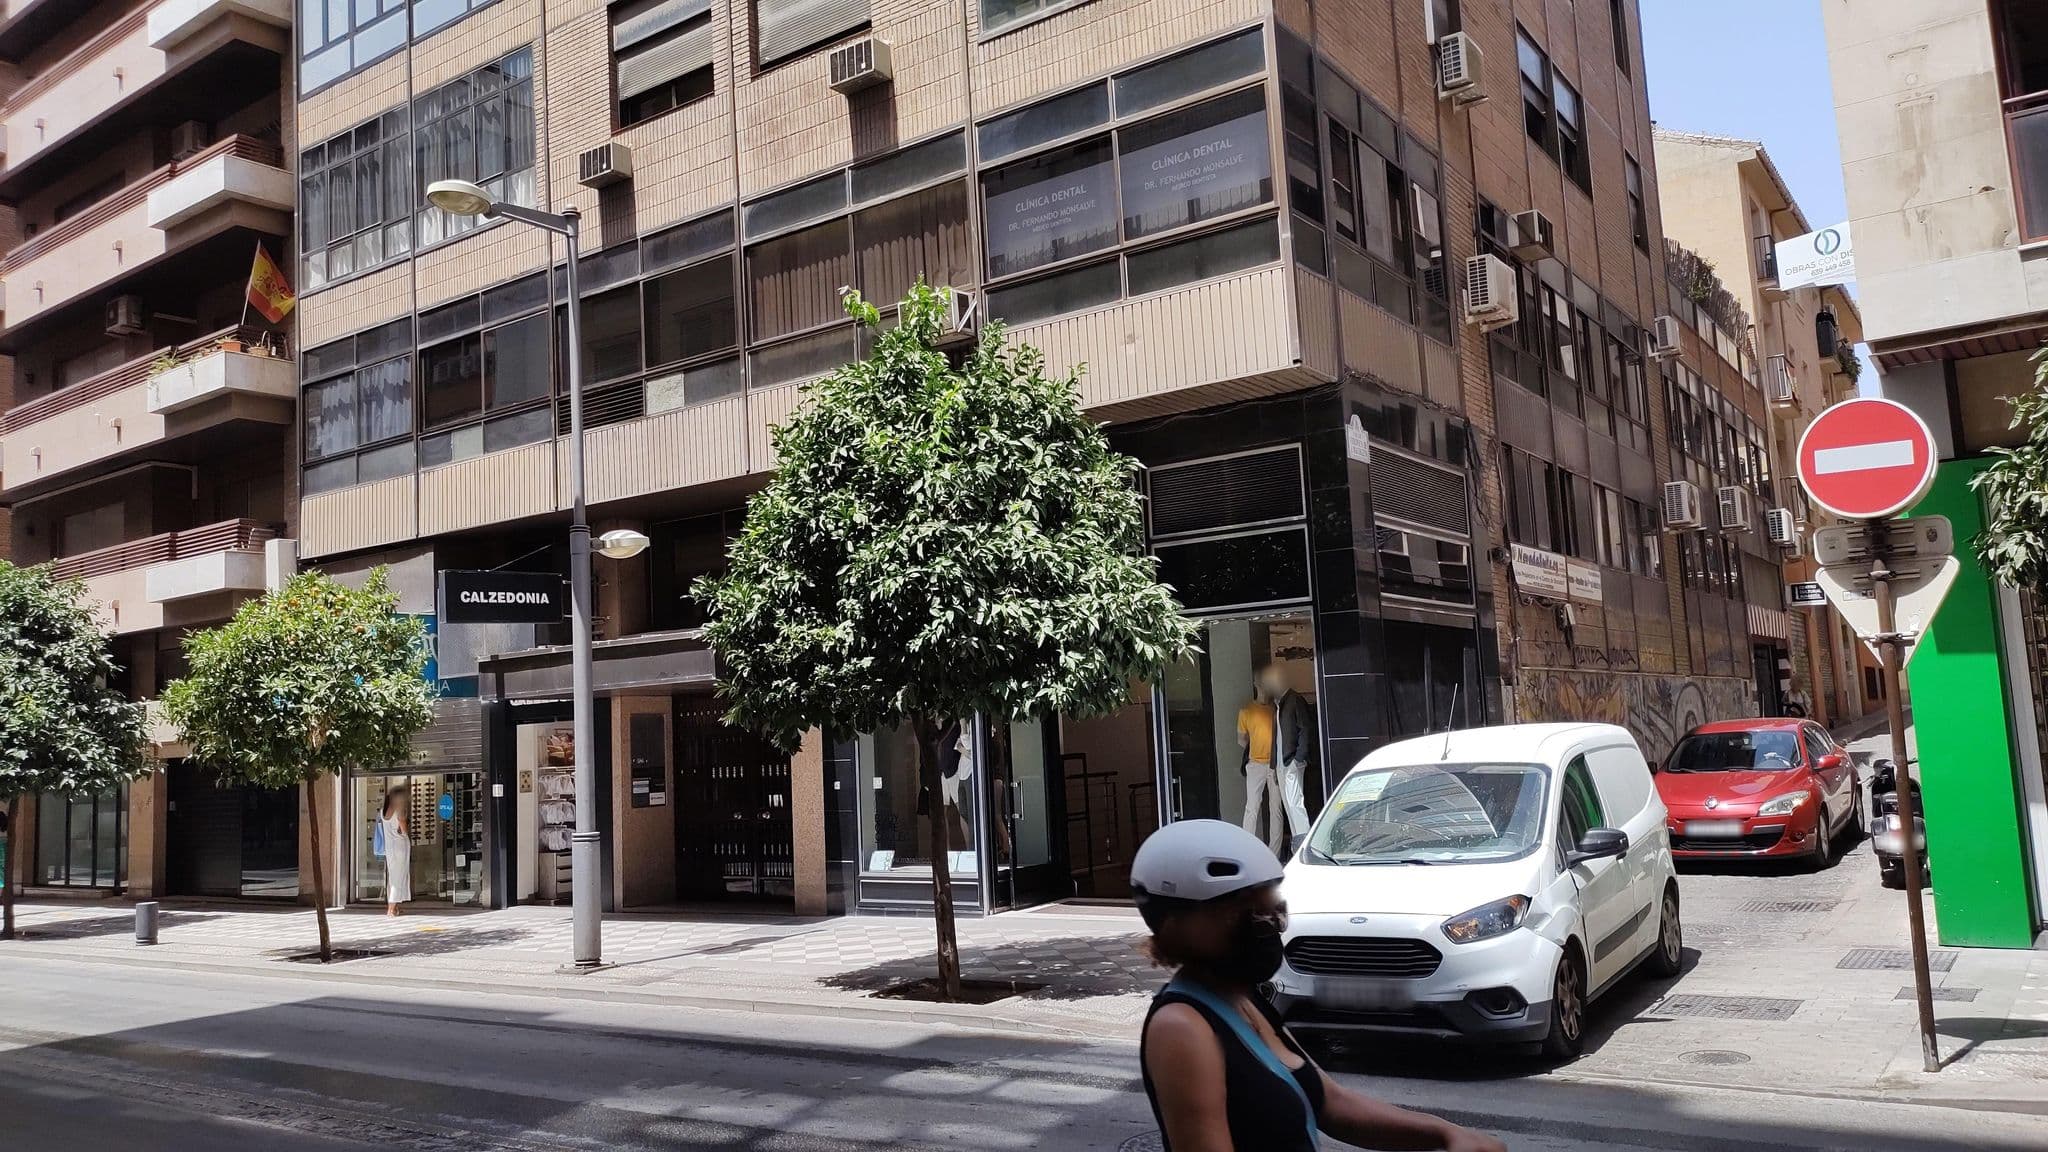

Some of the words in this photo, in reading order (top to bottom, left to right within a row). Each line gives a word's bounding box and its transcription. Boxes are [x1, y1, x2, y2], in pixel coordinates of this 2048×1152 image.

[1151, 152, 1191, 172] CLÍNICA
[1193, 138, 1232, 159] DENTAL
[1160, 167, 1201, 186] FERNANDO
[1015, 196, 1050, 213] CLÍNICA
[1051, 184, 1087, 202] DENTAL
[1022, 211, 1059, 228] FERNANDO
[1784, 261, 1816, 276] OBRAS
[1818, 255, 1838, 267] CON
[460, 590, 550, 605] CALZEDONIA
